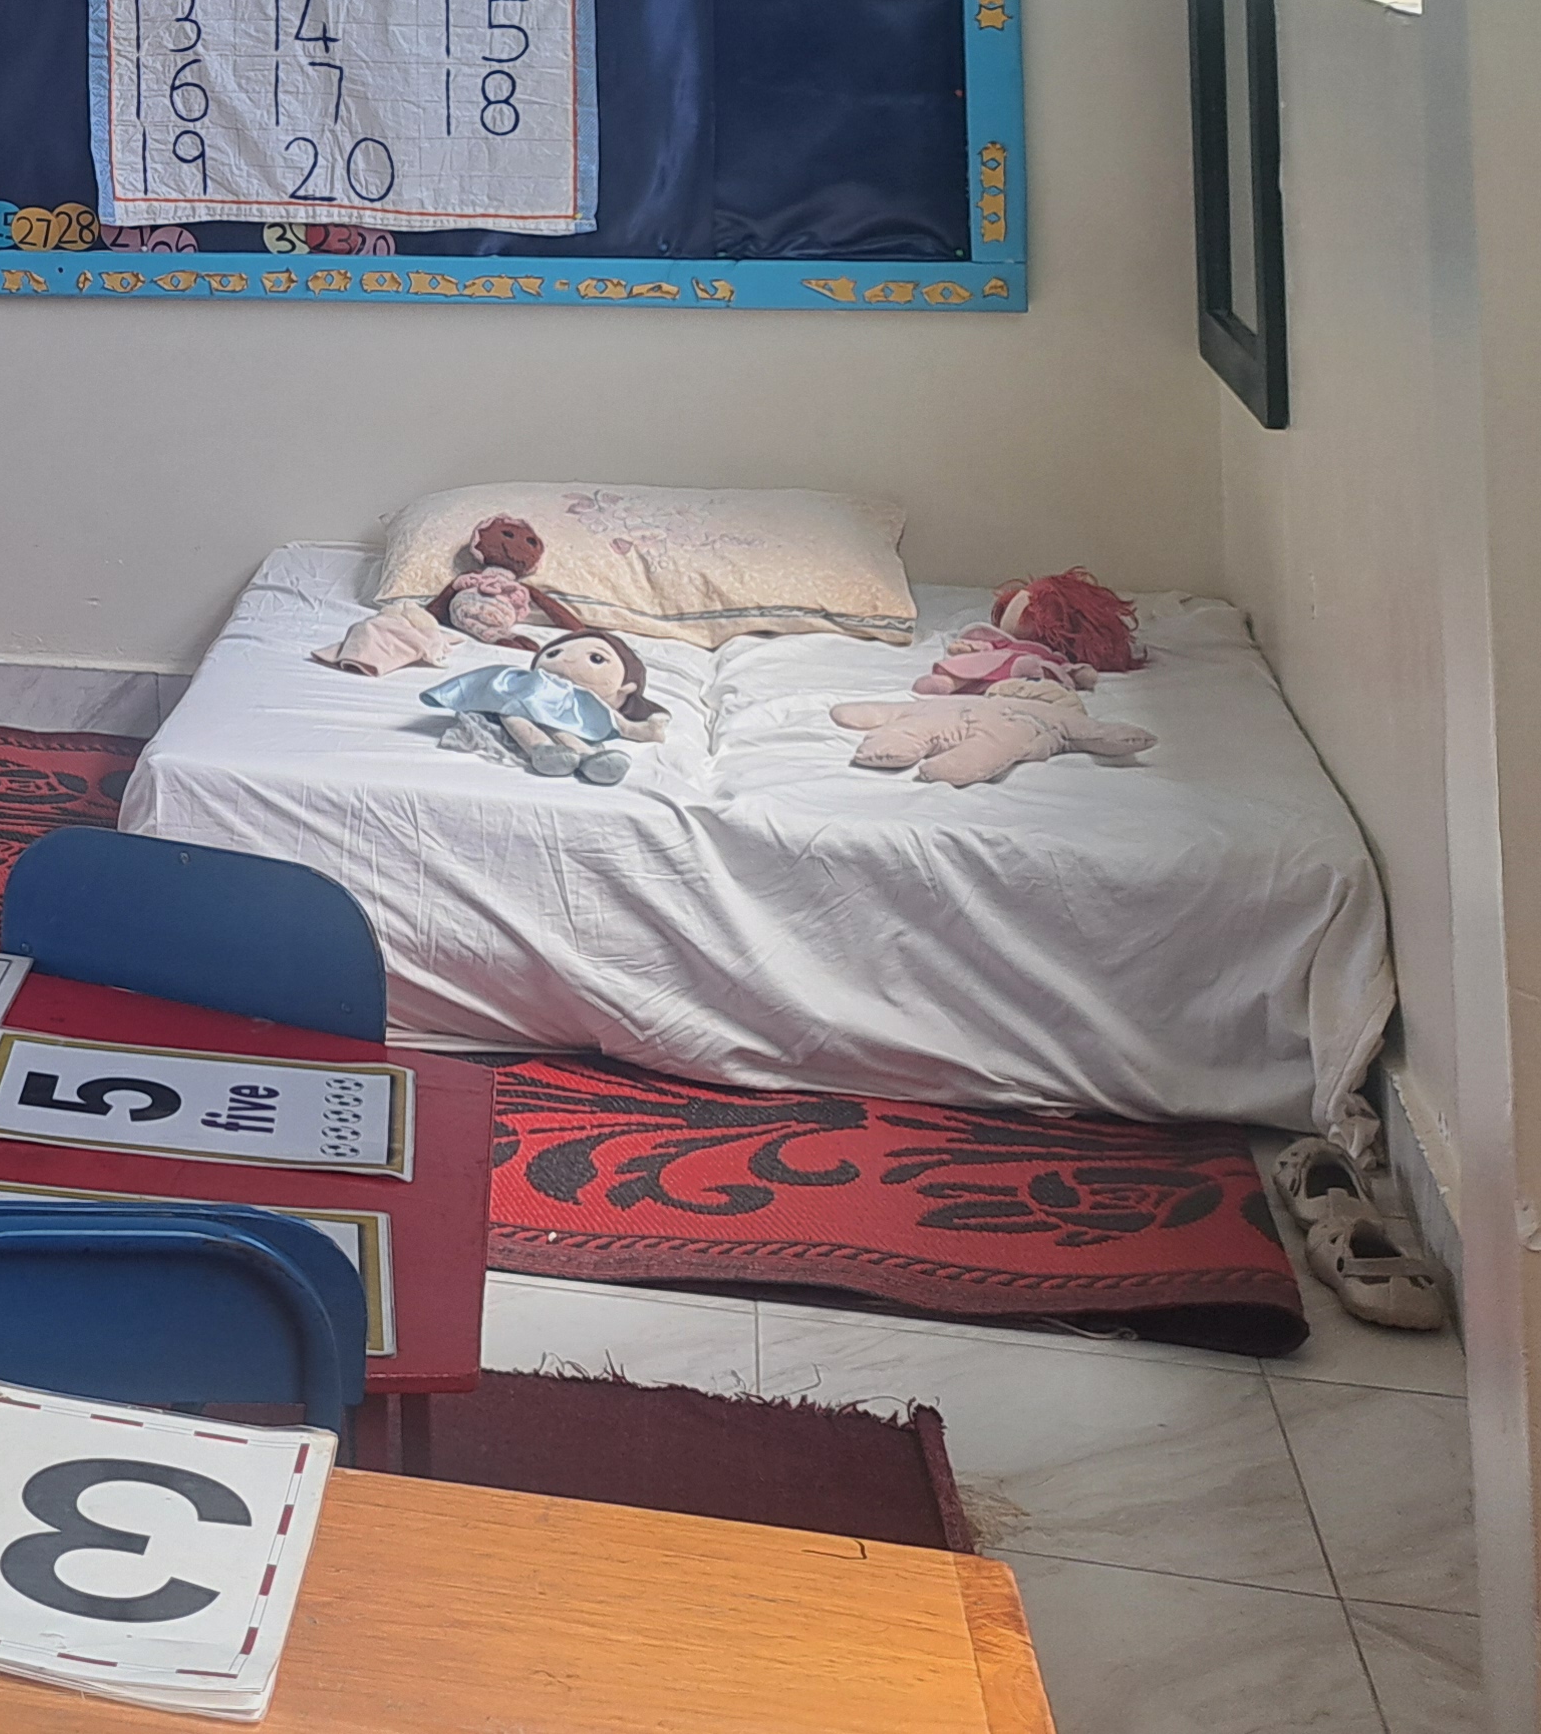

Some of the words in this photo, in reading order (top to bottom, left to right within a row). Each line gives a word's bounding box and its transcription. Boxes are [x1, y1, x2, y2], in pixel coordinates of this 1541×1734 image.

[136, 54, 209, 123] 16
[275, 59, 344, 127] 17
[445, 67, 520, 136] 18
[142, 126, 207, 196] 19
[284, 135, 395, 202] 20
[16, 216, 52, 249] 27
[54, 210, 98, 245] 28
[17, 1070, 182, 1124] 5
[200, 1081, 280, 1135] five
